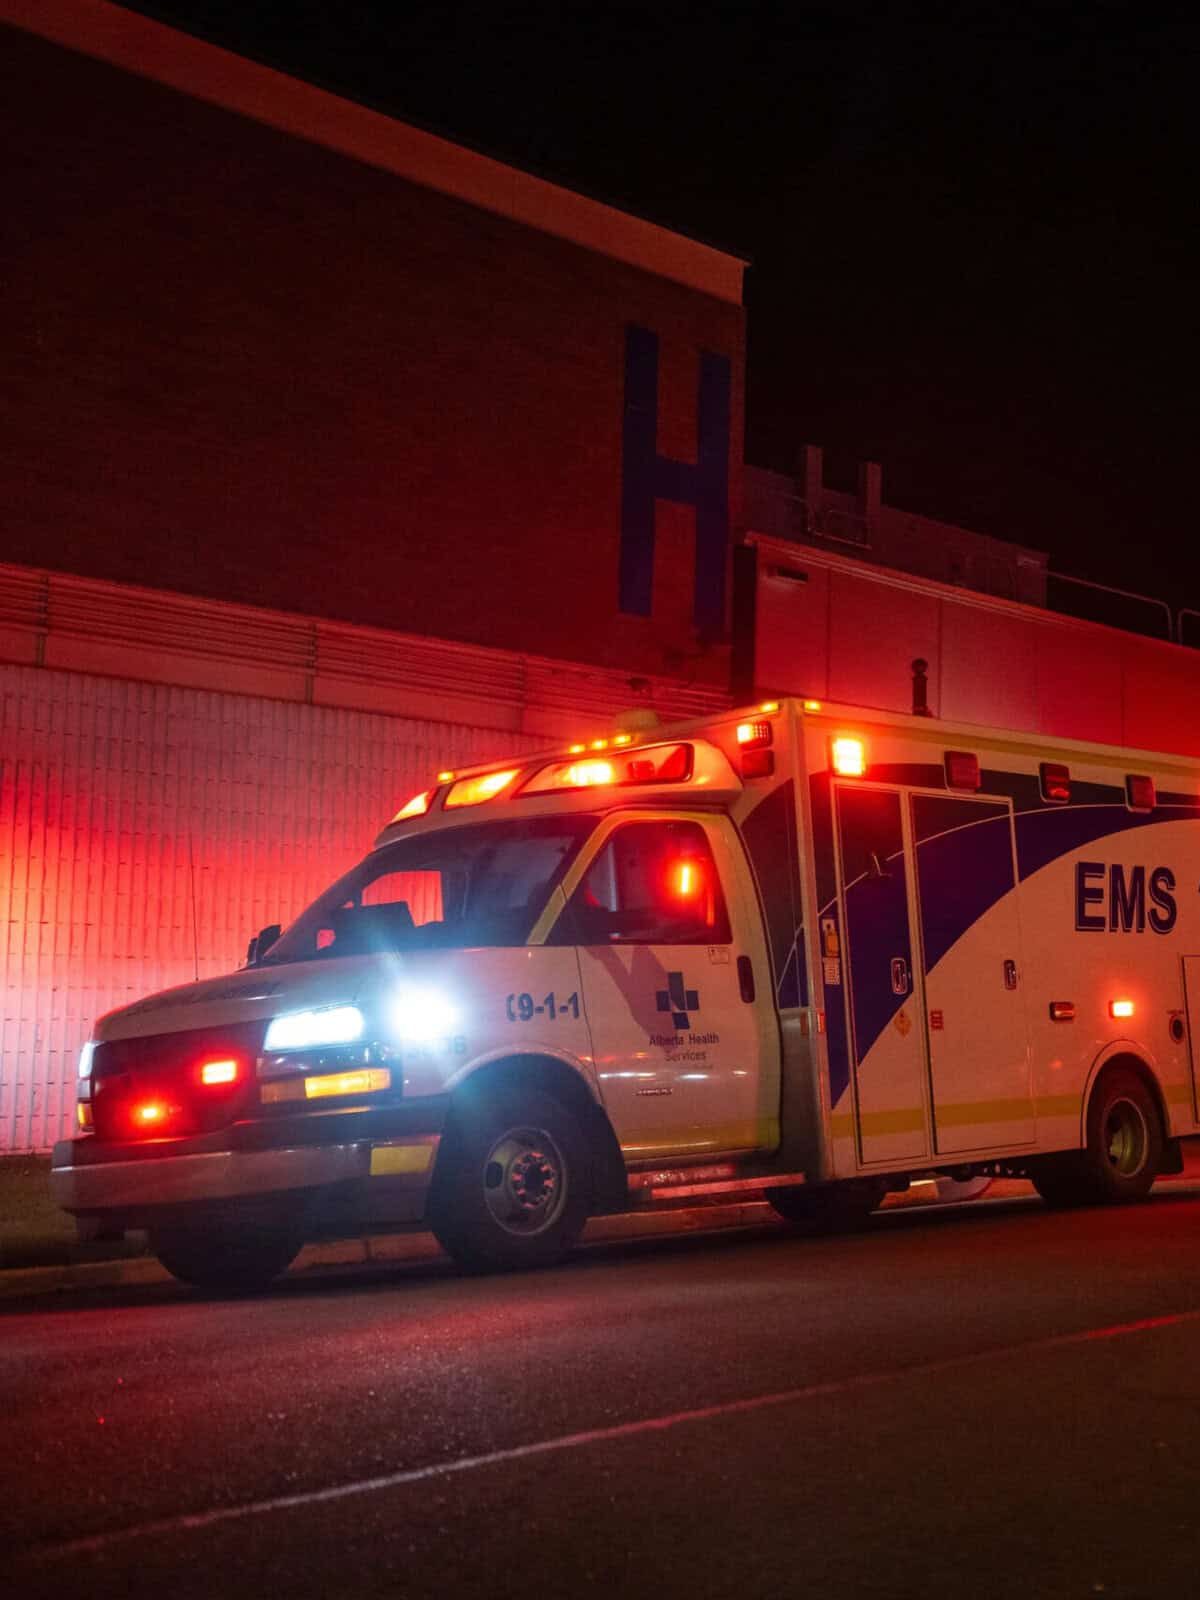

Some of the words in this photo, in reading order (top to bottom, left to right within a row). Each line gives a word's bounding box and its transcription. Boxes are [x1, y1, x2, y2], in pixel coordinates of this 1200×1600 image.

[621, 324, 732, 640] H
[1075, 861, 1177, 935] EMS
[649, 1033, 684, 1048] Alberta
[688, 1032, 720, 1046] Health
[664, 1049, 707, 1062] Services
